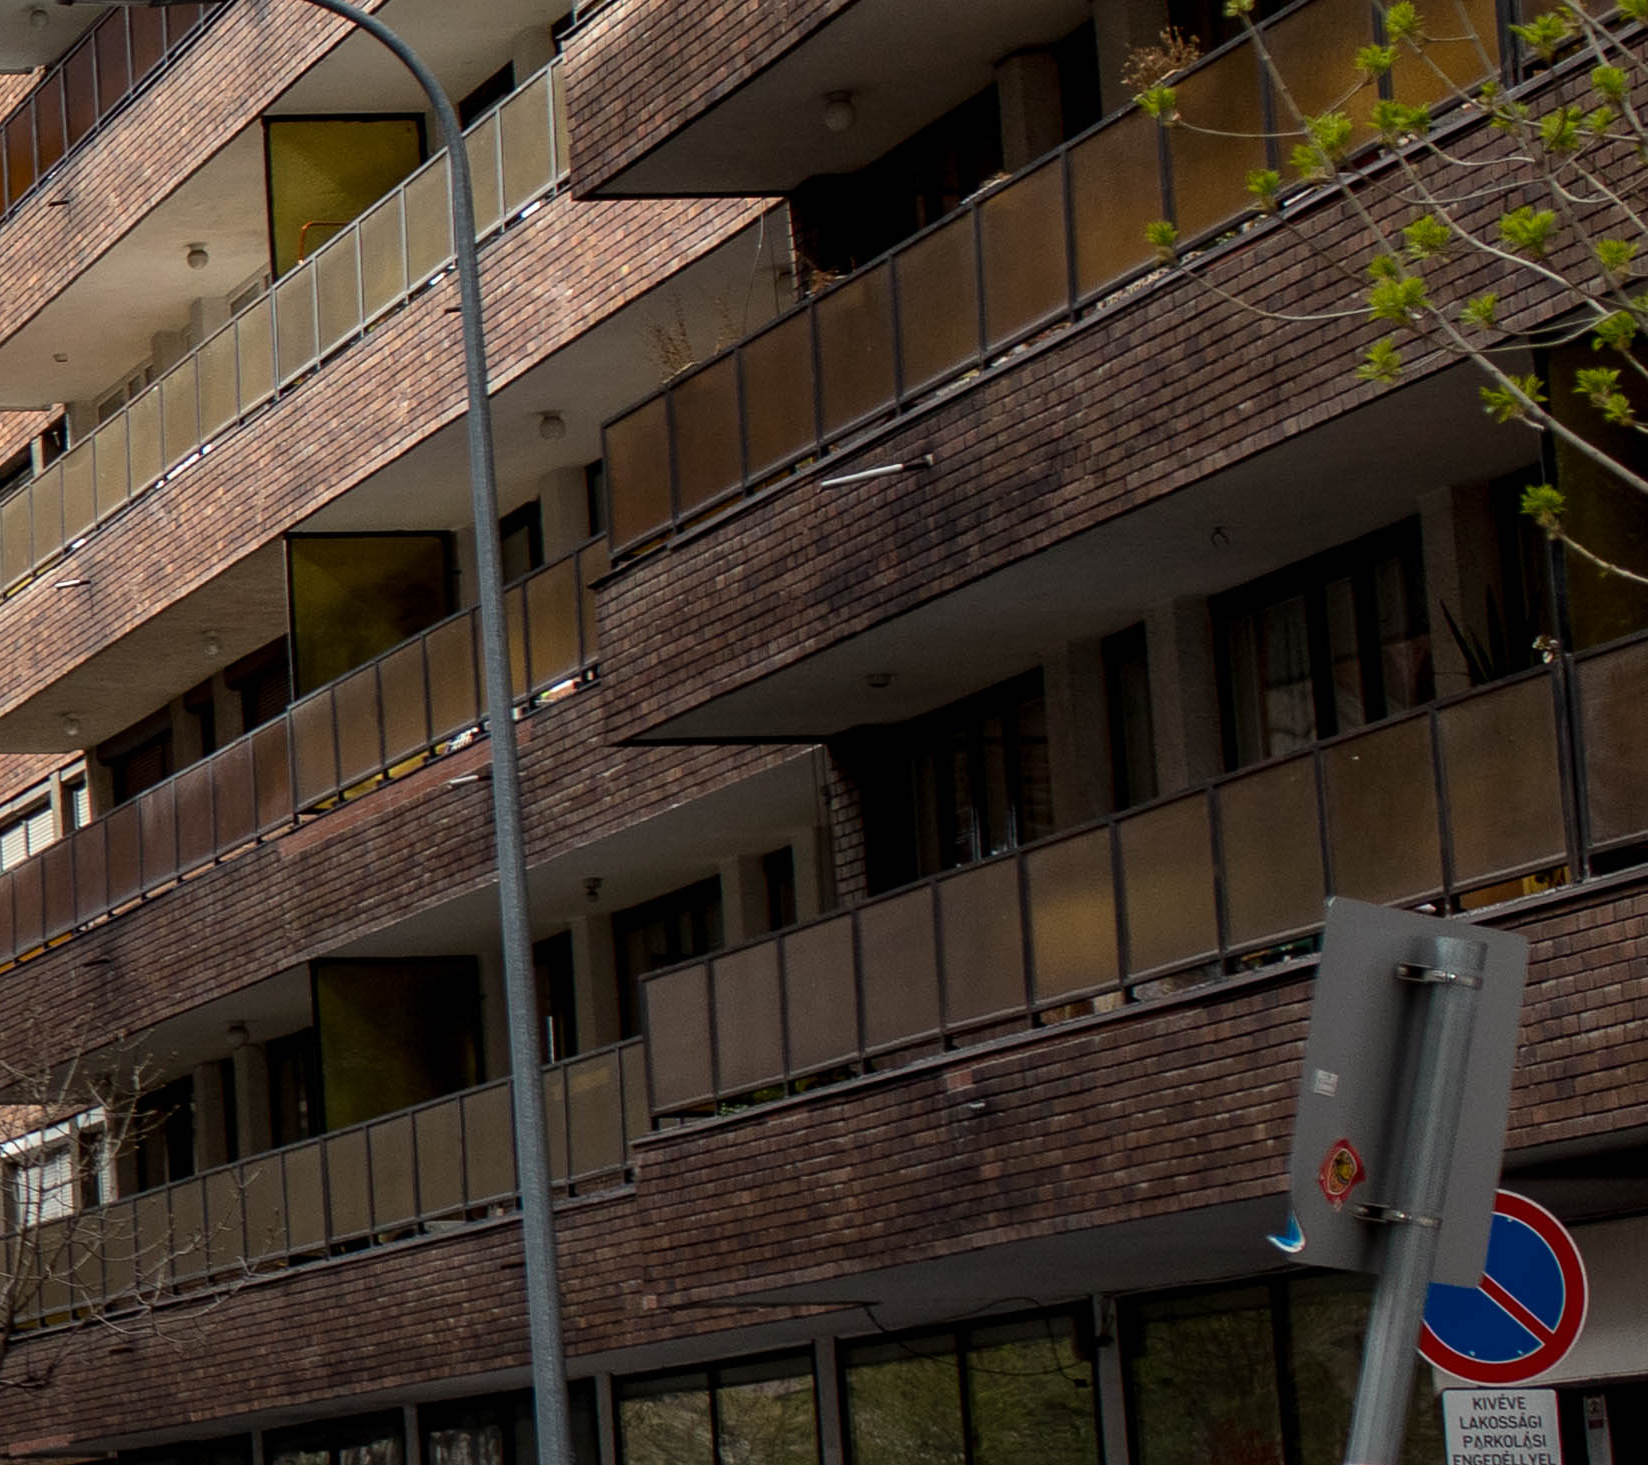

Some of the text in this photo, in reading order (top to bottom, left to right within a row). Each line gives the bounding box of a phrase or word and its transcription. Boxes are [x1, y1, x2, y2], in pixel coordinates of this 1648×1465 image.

[1472, 1394, 1527, 1410] KIVÉVE
[1459, 1413, 1543, 1430] LAKOSSÁGI
[1462, 1432, 1547, 1448] PARKOLÁSI
